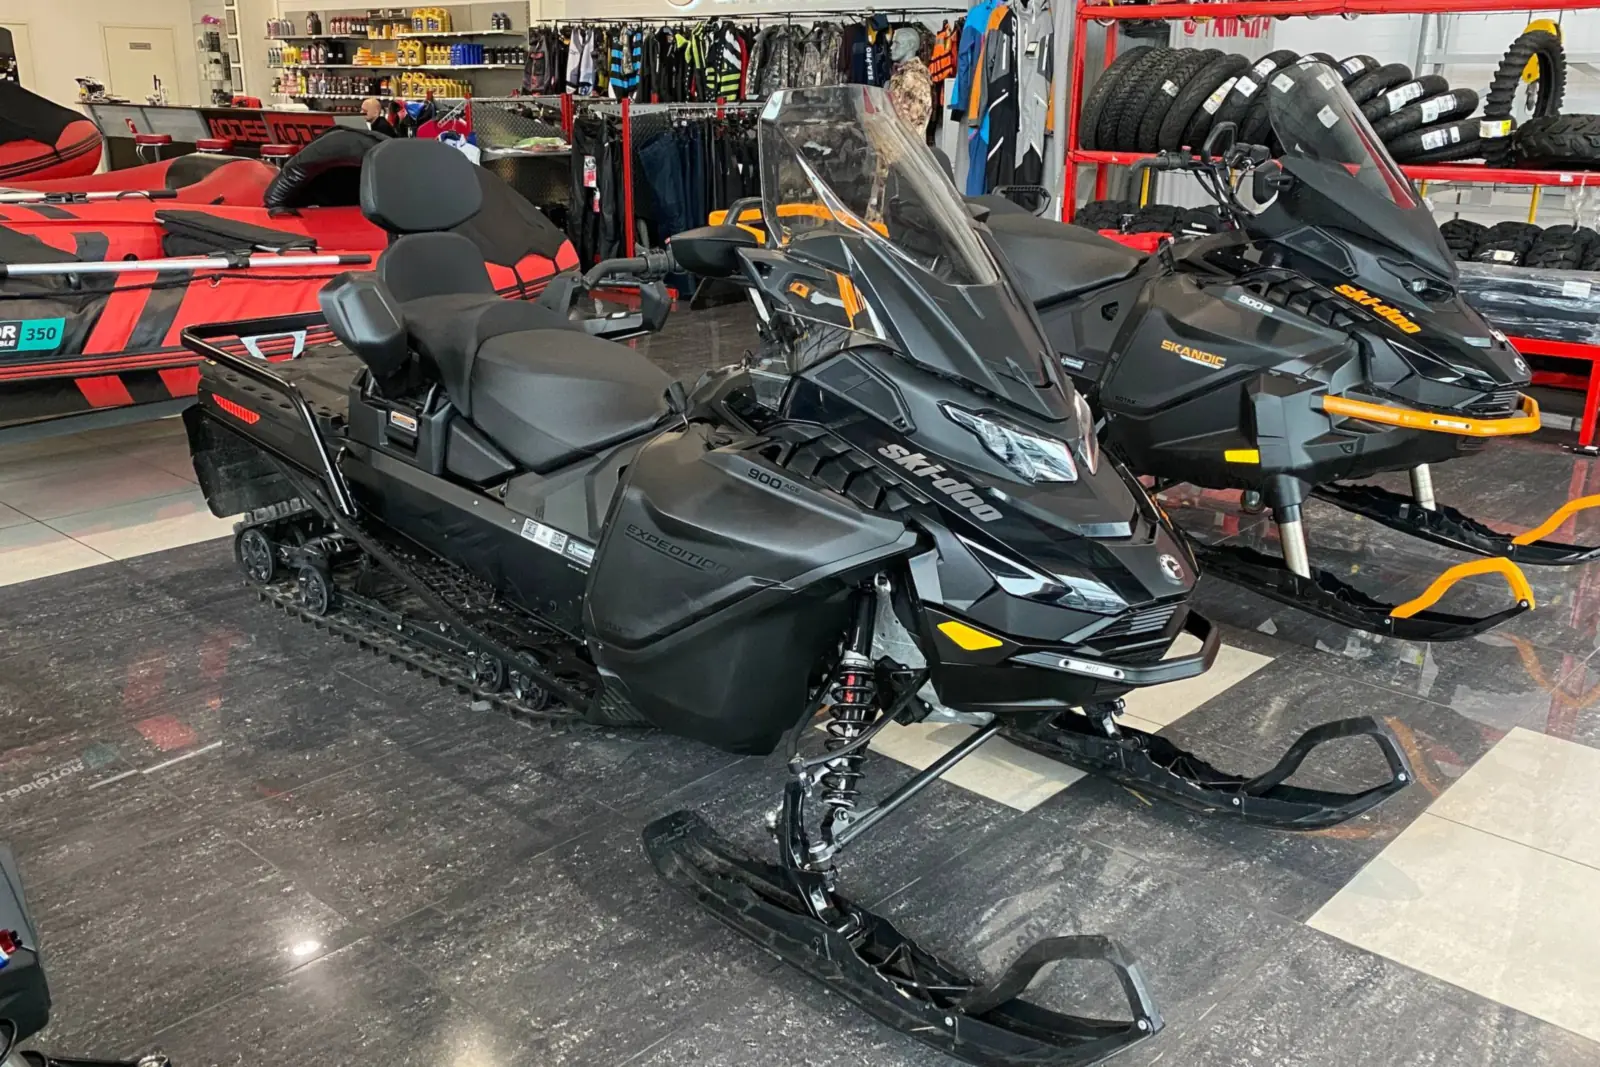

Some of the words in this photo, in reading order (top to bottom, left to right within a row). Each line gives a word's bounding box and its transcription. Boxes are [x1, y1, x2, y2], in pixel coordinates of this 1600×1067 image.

[865, 46, 874, 80] SEA-PRO
[1238, 294, 1264, 310] 900
[0, 325, 16, 339] R
[25, 326, 57, 341] 350
[1160, 339, 1228, 367] SKANDIC
[747, 468, 782, 490] 900
[784, 483, 801, 496] ACE
[877, 443, 1004, 523] ski-doo
[626, 523, 735, 580] EXPEDITION
